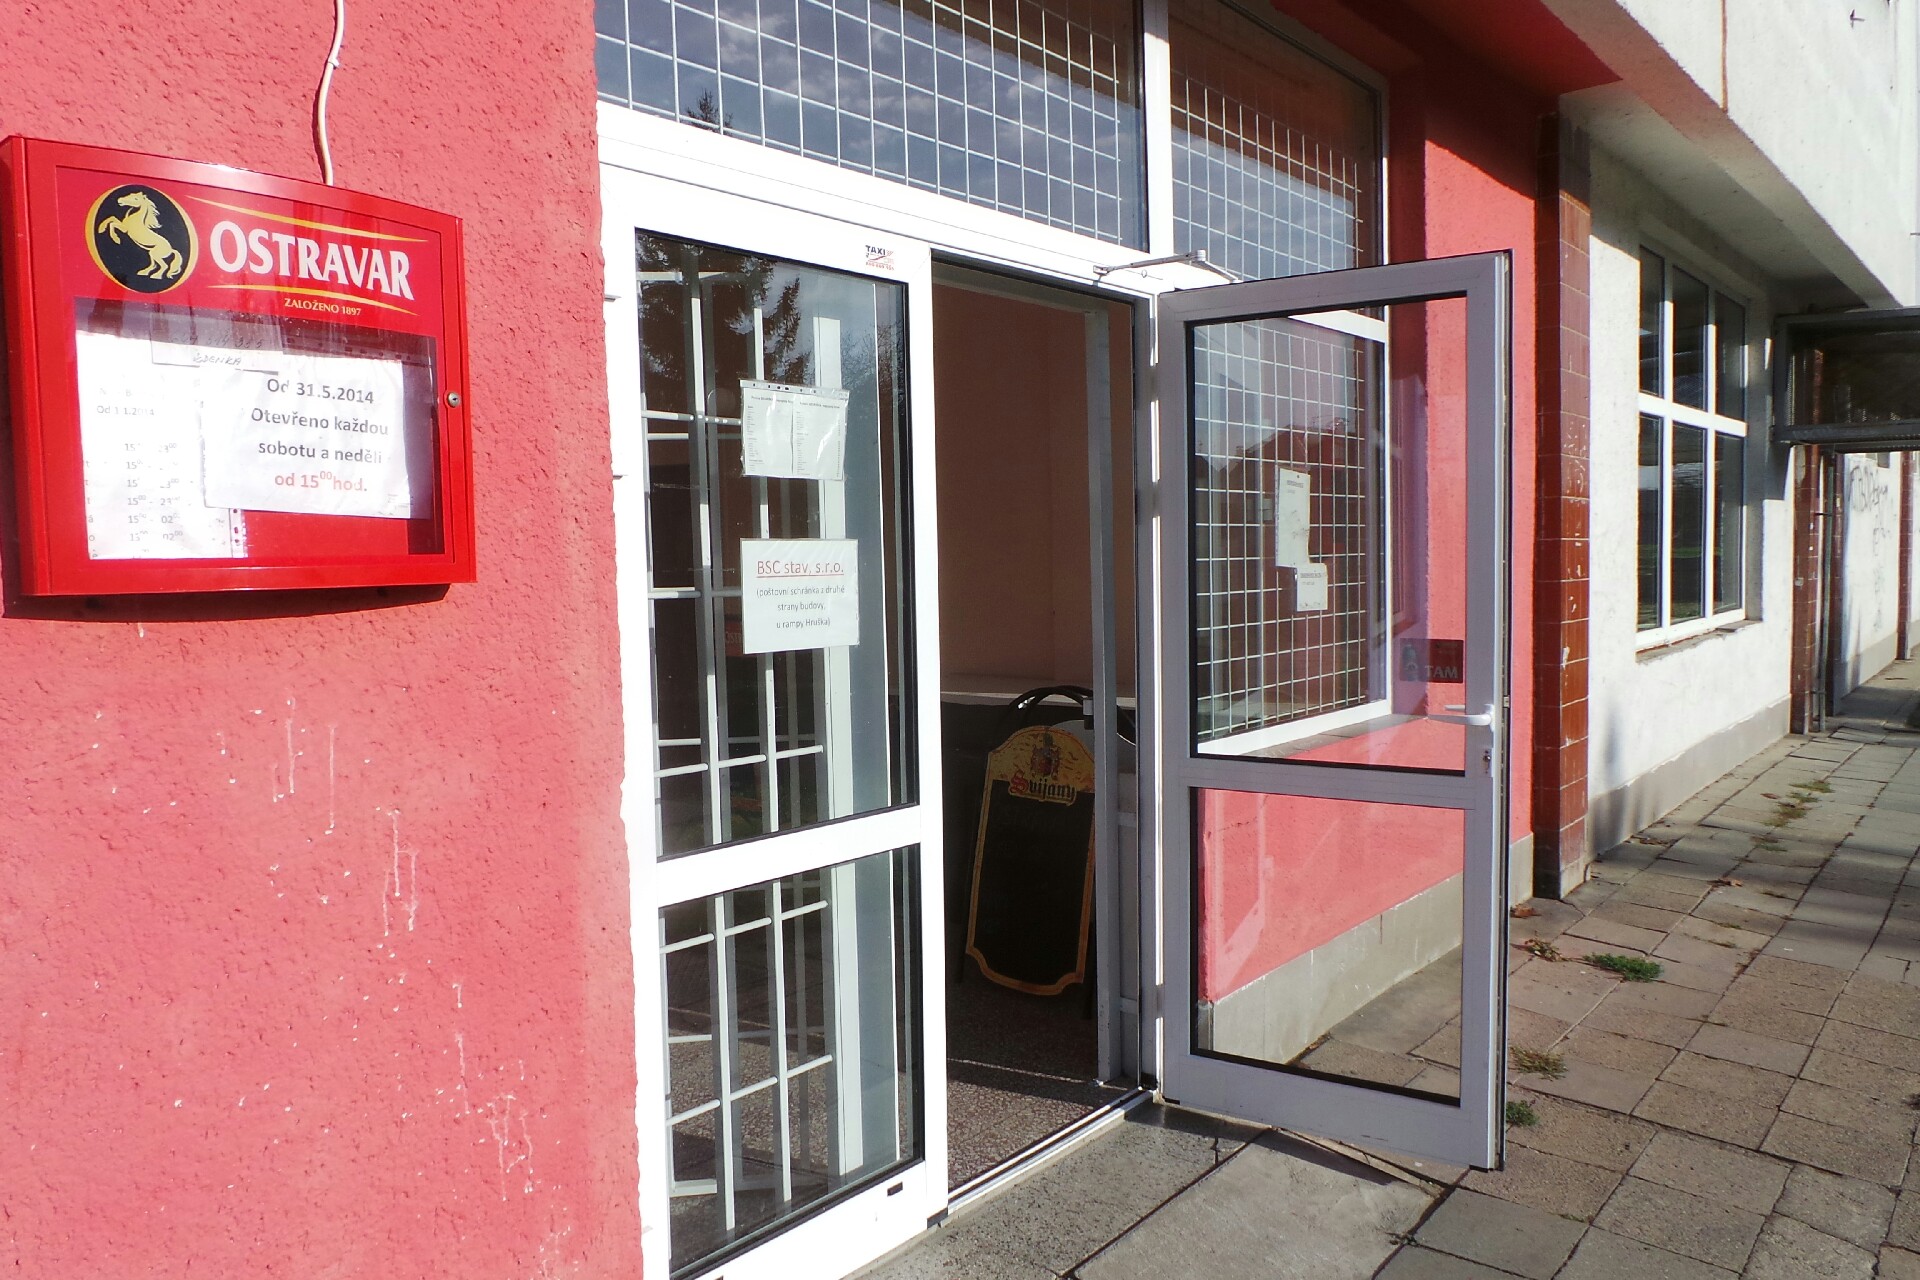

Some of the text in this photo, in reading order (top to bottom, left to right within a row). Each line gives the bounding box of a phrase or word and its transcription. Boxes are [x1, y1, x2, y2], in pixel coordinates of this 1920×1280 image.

[865, 244, 886, 256] TAXI
[210, 220, 415, 300] OSTRAVAR
[284, 298, 362, 316] ZALOŽENO 1897
[267, 378, 374, 404] Od 31.5.2014
[251, 407, 389, 436] Otevřeno každou
[258, 440, 382, 464] sobotu a neděli
[274, 472, 295, 486] od
[757, 560, 781, 575] BSC
[815, 561, 844, 574] s.r.o.
[777, 602, 799, 613] strany
